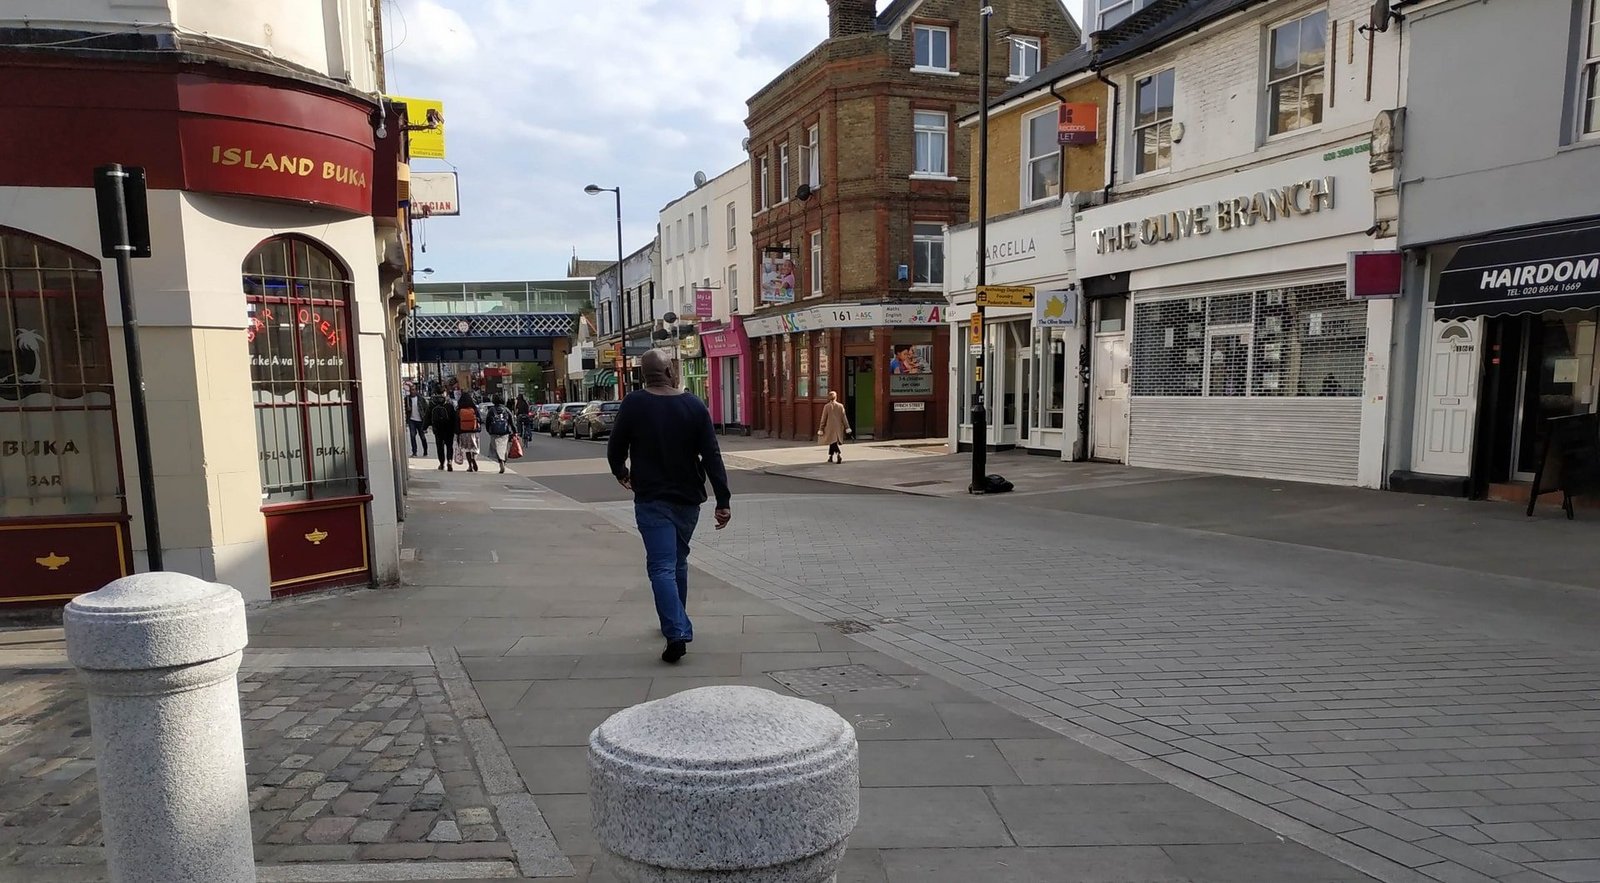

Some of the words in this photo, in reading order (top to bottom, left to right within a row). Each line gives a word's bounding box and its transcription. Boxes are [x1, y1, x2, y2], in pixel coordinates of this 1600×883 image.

[1060, 133, 1075, 141] LET
[212, 146, 314, 176] ISLAND
[322, 162, 366, 188] BUKA
[1091, 222, 1137, 254] THE
[1139, 205, 1210, 245] OLIVE
[1216, 176, 1335, 231] BRANCH
[976, 238, 1036, 262] ARCELLA
[1480, 258, 1600, 289] HAIRDOM
[774, 288, 793, 298] ASC
[1523, 287, 1538, 295] 020
[1539, 284, 1559, 293] 8694
[1562, 282, 1582, 291] 1669
[781, 314, 800, 332] ASC
[832, 311, 851, 321] 161
[299, 309, 339, 346] OPEN
[2, 440, 80, 456] BUKA
[260, 449, 302, 460] ISLAND
[29, 475, 63, 487] BAR
